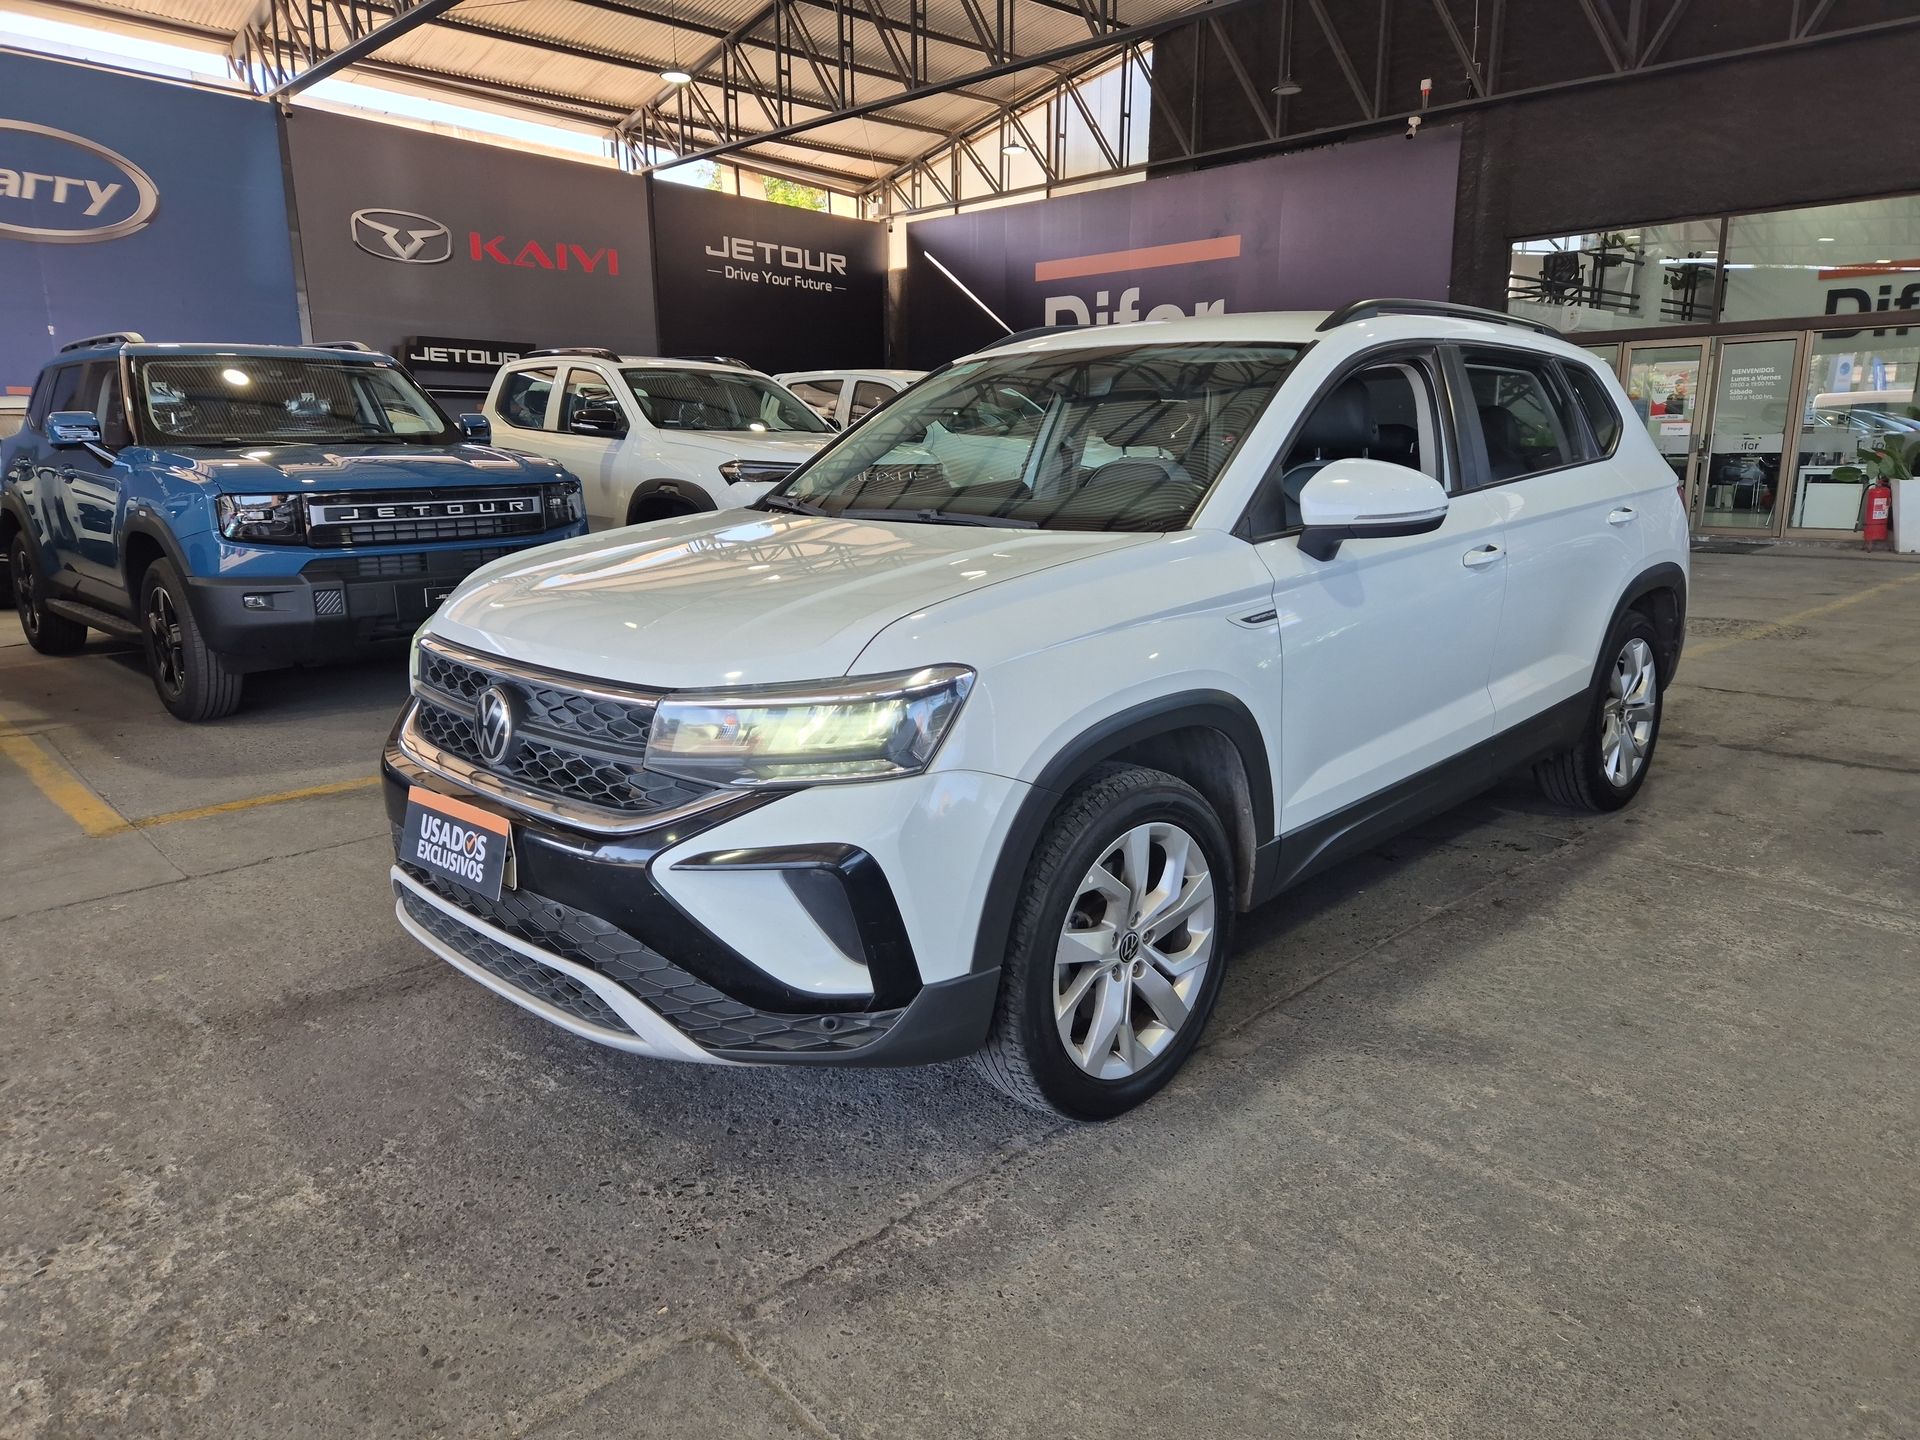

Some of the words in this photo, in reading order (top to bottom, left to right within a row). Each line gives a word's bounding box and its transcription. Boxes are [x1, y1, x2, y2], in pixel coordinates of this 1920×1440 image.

[469, 231, 620, 276] KAIYI
[705, 236, 846, 275] JETOUR
[725, 266, 759, 283] Drive
[762, 270, 792, 287] Your
[795, 275, 833, 292] Future
[410, 346, 521, 365] JETOUR
[1732, 367, 1775, 375] BIENVENIDOS
[340, 501, 524, 521] JETOUR
[420, 813, 487, 861] USADOS
[416, 838, 485, 883] EXCLUSIVOS
